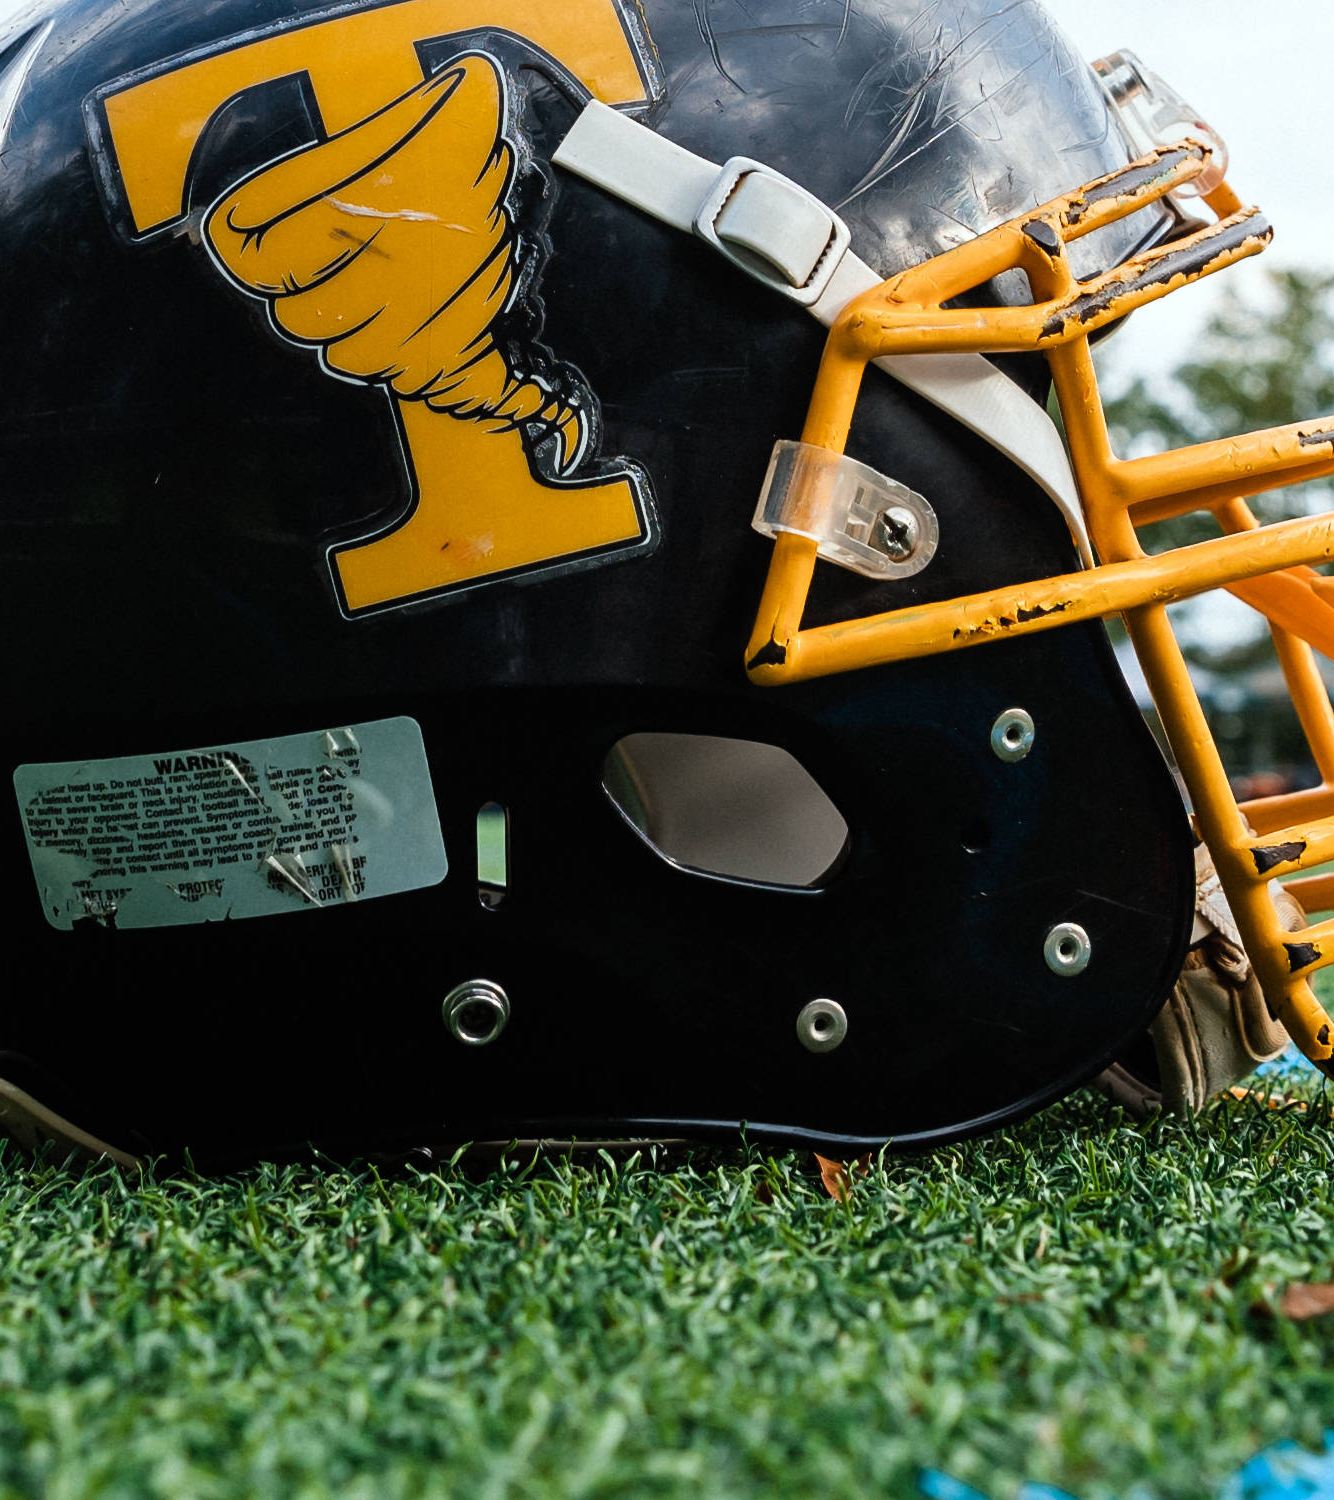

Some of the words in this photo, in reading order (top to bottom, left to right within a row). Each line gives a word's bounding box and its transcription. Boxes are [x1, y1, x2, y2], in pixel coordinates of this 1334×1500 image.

[25, 808, 35, 816] to
[66, 805, 97, 814] severe
[100, 801, 124, 811] brain
[128, 801, 138, 809] or
[142, 798, 165, 807] neck
[303, 777, 314, 786] or
[67, 783, 90, 793] head
[93, 782, 108, 793] up.
[110, 780, 124, 789] Do
[126, 778, 142, 788] not
[194, 770, 221, 783] spear
[75, 795, 84, 803] or
[140, 787, 161, 797] This
[165, 786, 173, 795] is
[186, 780, 227, 792] violation
[286, 767, 312, 778] rules
[55, 817, 65, 826] to
[68, 816, 88, 826] your
[145, 806, 183, 818] Contact
[188, 804, 197, 813] in
[201, 799, 238, 812] football
[303, 786, 313, 797] in
[62, 825, 88, 836] which
[92, 826, 104, 834] no
[142, 821, 159, 830] can
[163, 815, 202, 828] prevent.
[207, 808, 260, 823] Symptoms
[333, 792, 342, 802] of
[137, 828, 187, 841] headache,
[192, 824, 227, 835] nausea
[232, 821, 242, 830] or
[316, 806, 335, 818] you
[91, 846, 112, 857] stop
[116, 844, 134, 854] and
[138, 841, 167, 853] report
[171, 838, 196, 848] them
[200, 836, 211, 845] to
[215, 833, 238, 844] your
[280, 820, 316, 833] trainer,
[321, 815, 340, 827] and
[113, 856, 123, 865] or
[126, 852, 160, 864] contact
[164, 849, 185, 860] until
[188, 847, 199, 857] all
[202, 841, 254, 856] symptoms
[276, 834, 302, 847] gone
[305, 829, 324, 841] and
[327, 826, 346, 838] you
[128, 864, 147, 874] this
[150, 859, 189, 872] warning
[193, 857, 213, 868] may
[217, 853, 238, 864] lead
[242, 851, 252, 861] to
[299, 841, 319, 852] and
